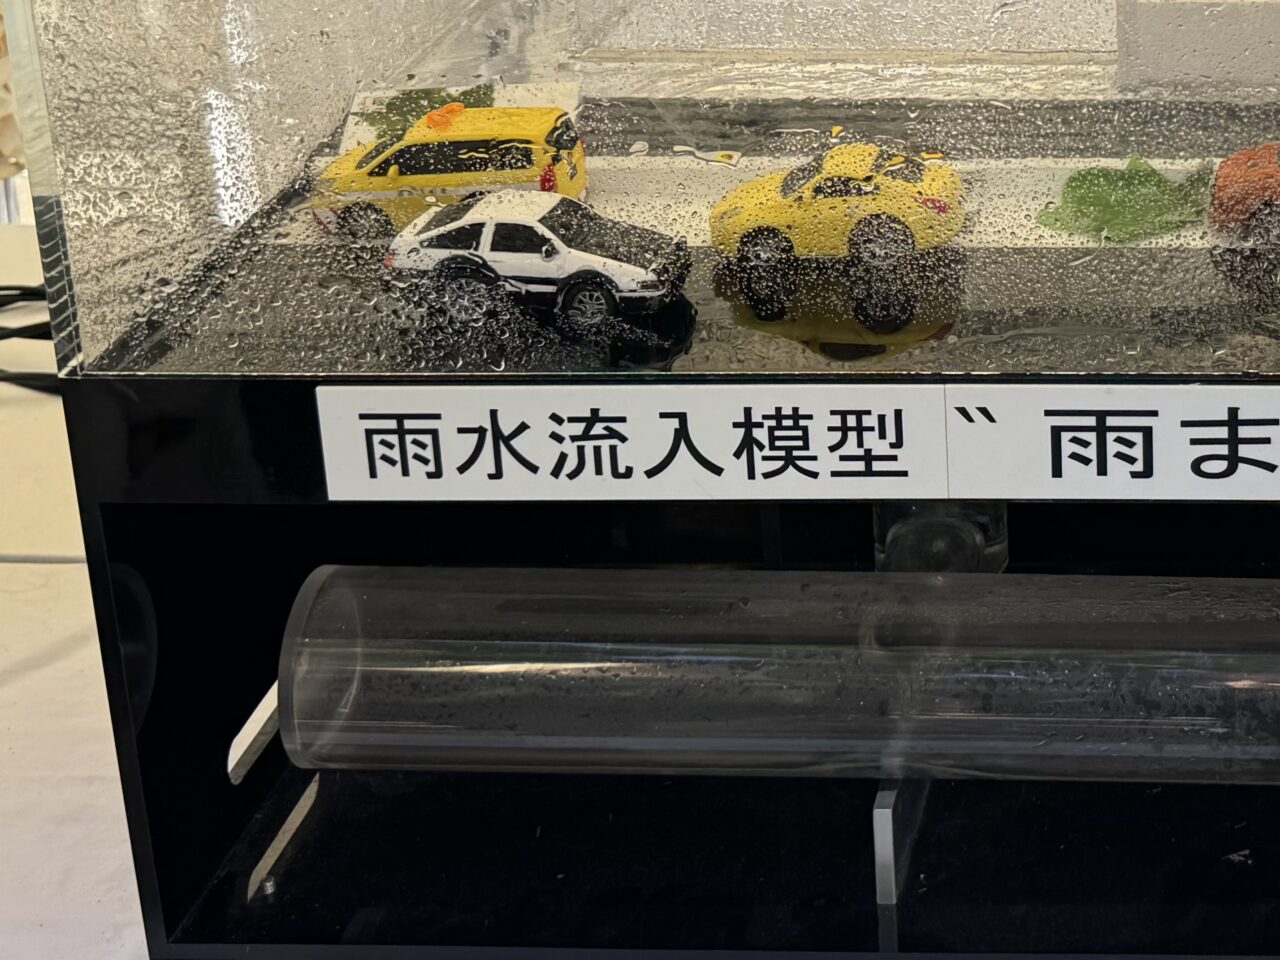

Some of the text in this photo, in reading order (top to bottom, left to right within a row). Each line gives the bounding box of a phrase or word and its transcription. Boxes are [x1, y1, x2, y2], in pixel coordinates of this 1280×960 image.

[358, 406, 909, 481] 雨水流入模型
